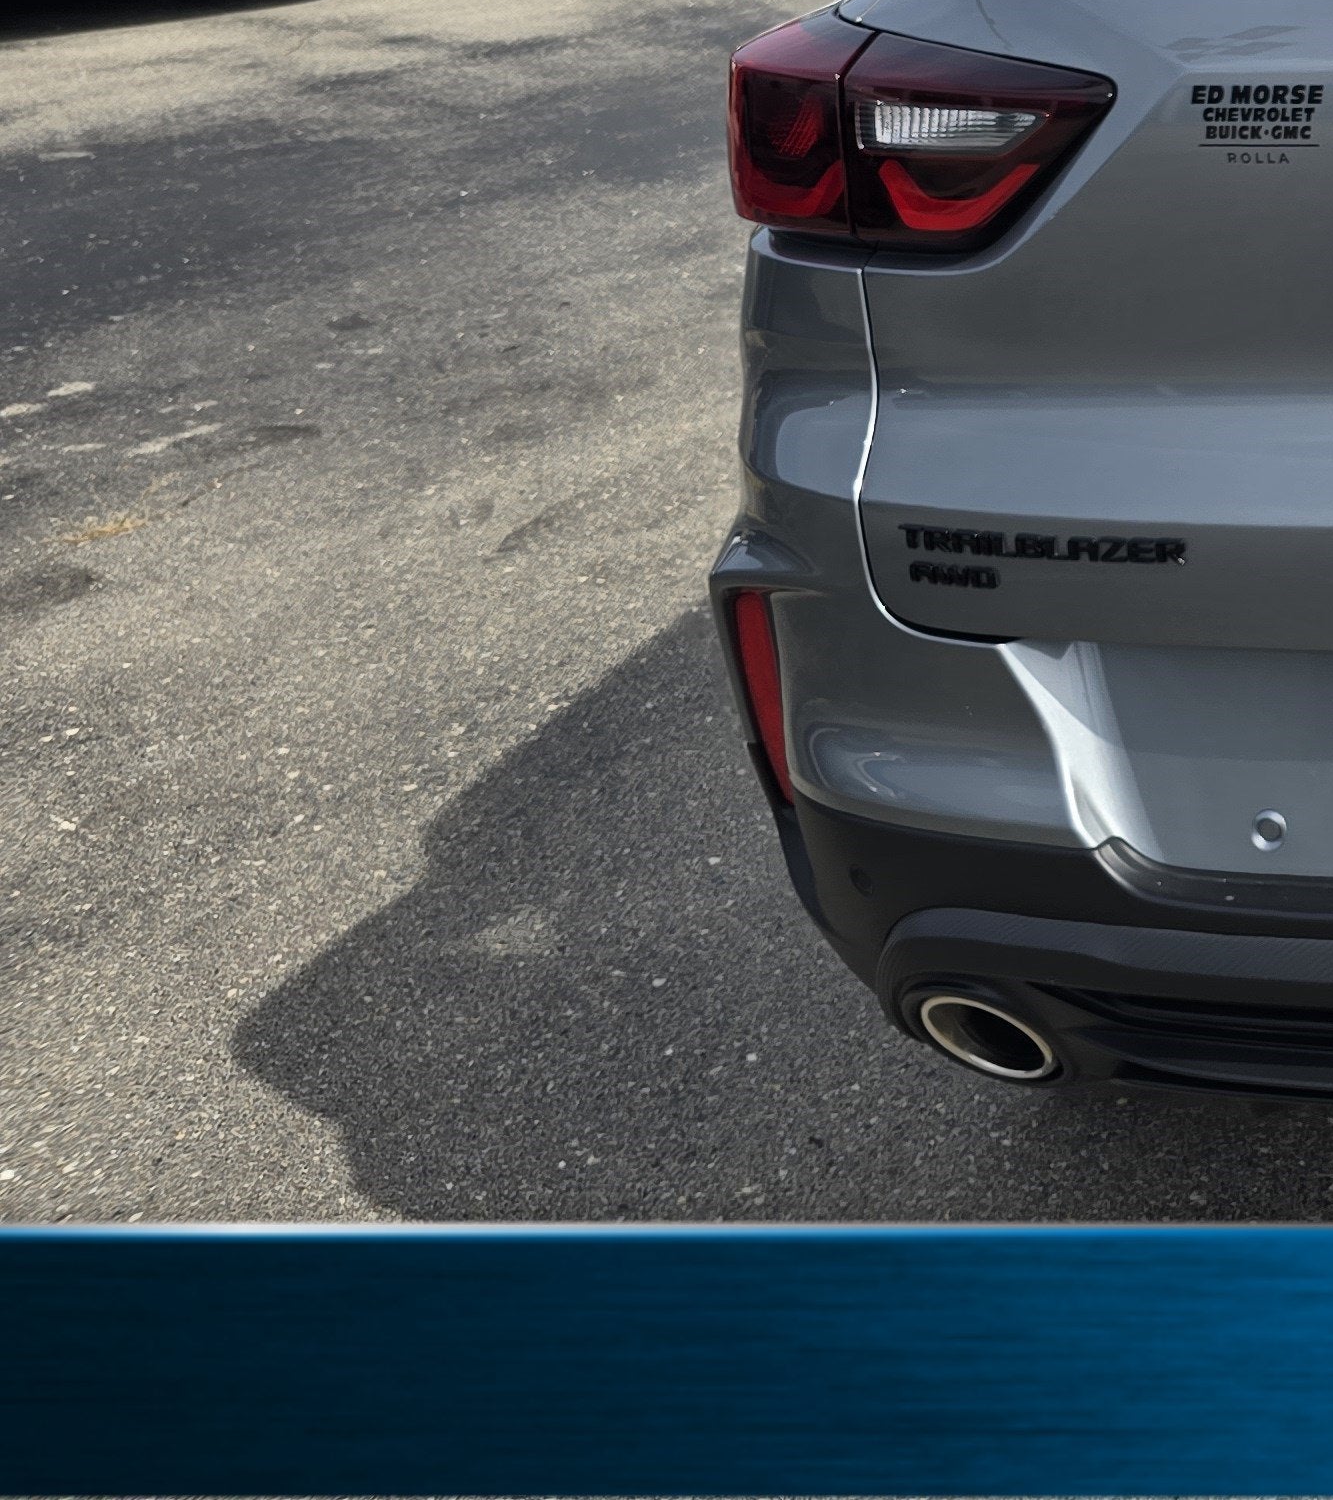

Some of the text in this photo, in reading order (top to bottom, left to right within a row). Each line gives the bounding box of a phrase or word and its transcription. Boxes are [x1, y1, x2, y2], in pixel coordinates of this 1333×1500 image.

[1191, 84, 1324, 105] ED MORSE
[1202, 107, 1315, 122] CHEVROLET
[1227, 152, 1290, 164] ROLLA
[898, 523, 1188, 566] TRAILBLAZER
[908, 560, 1001, 590] AWD
